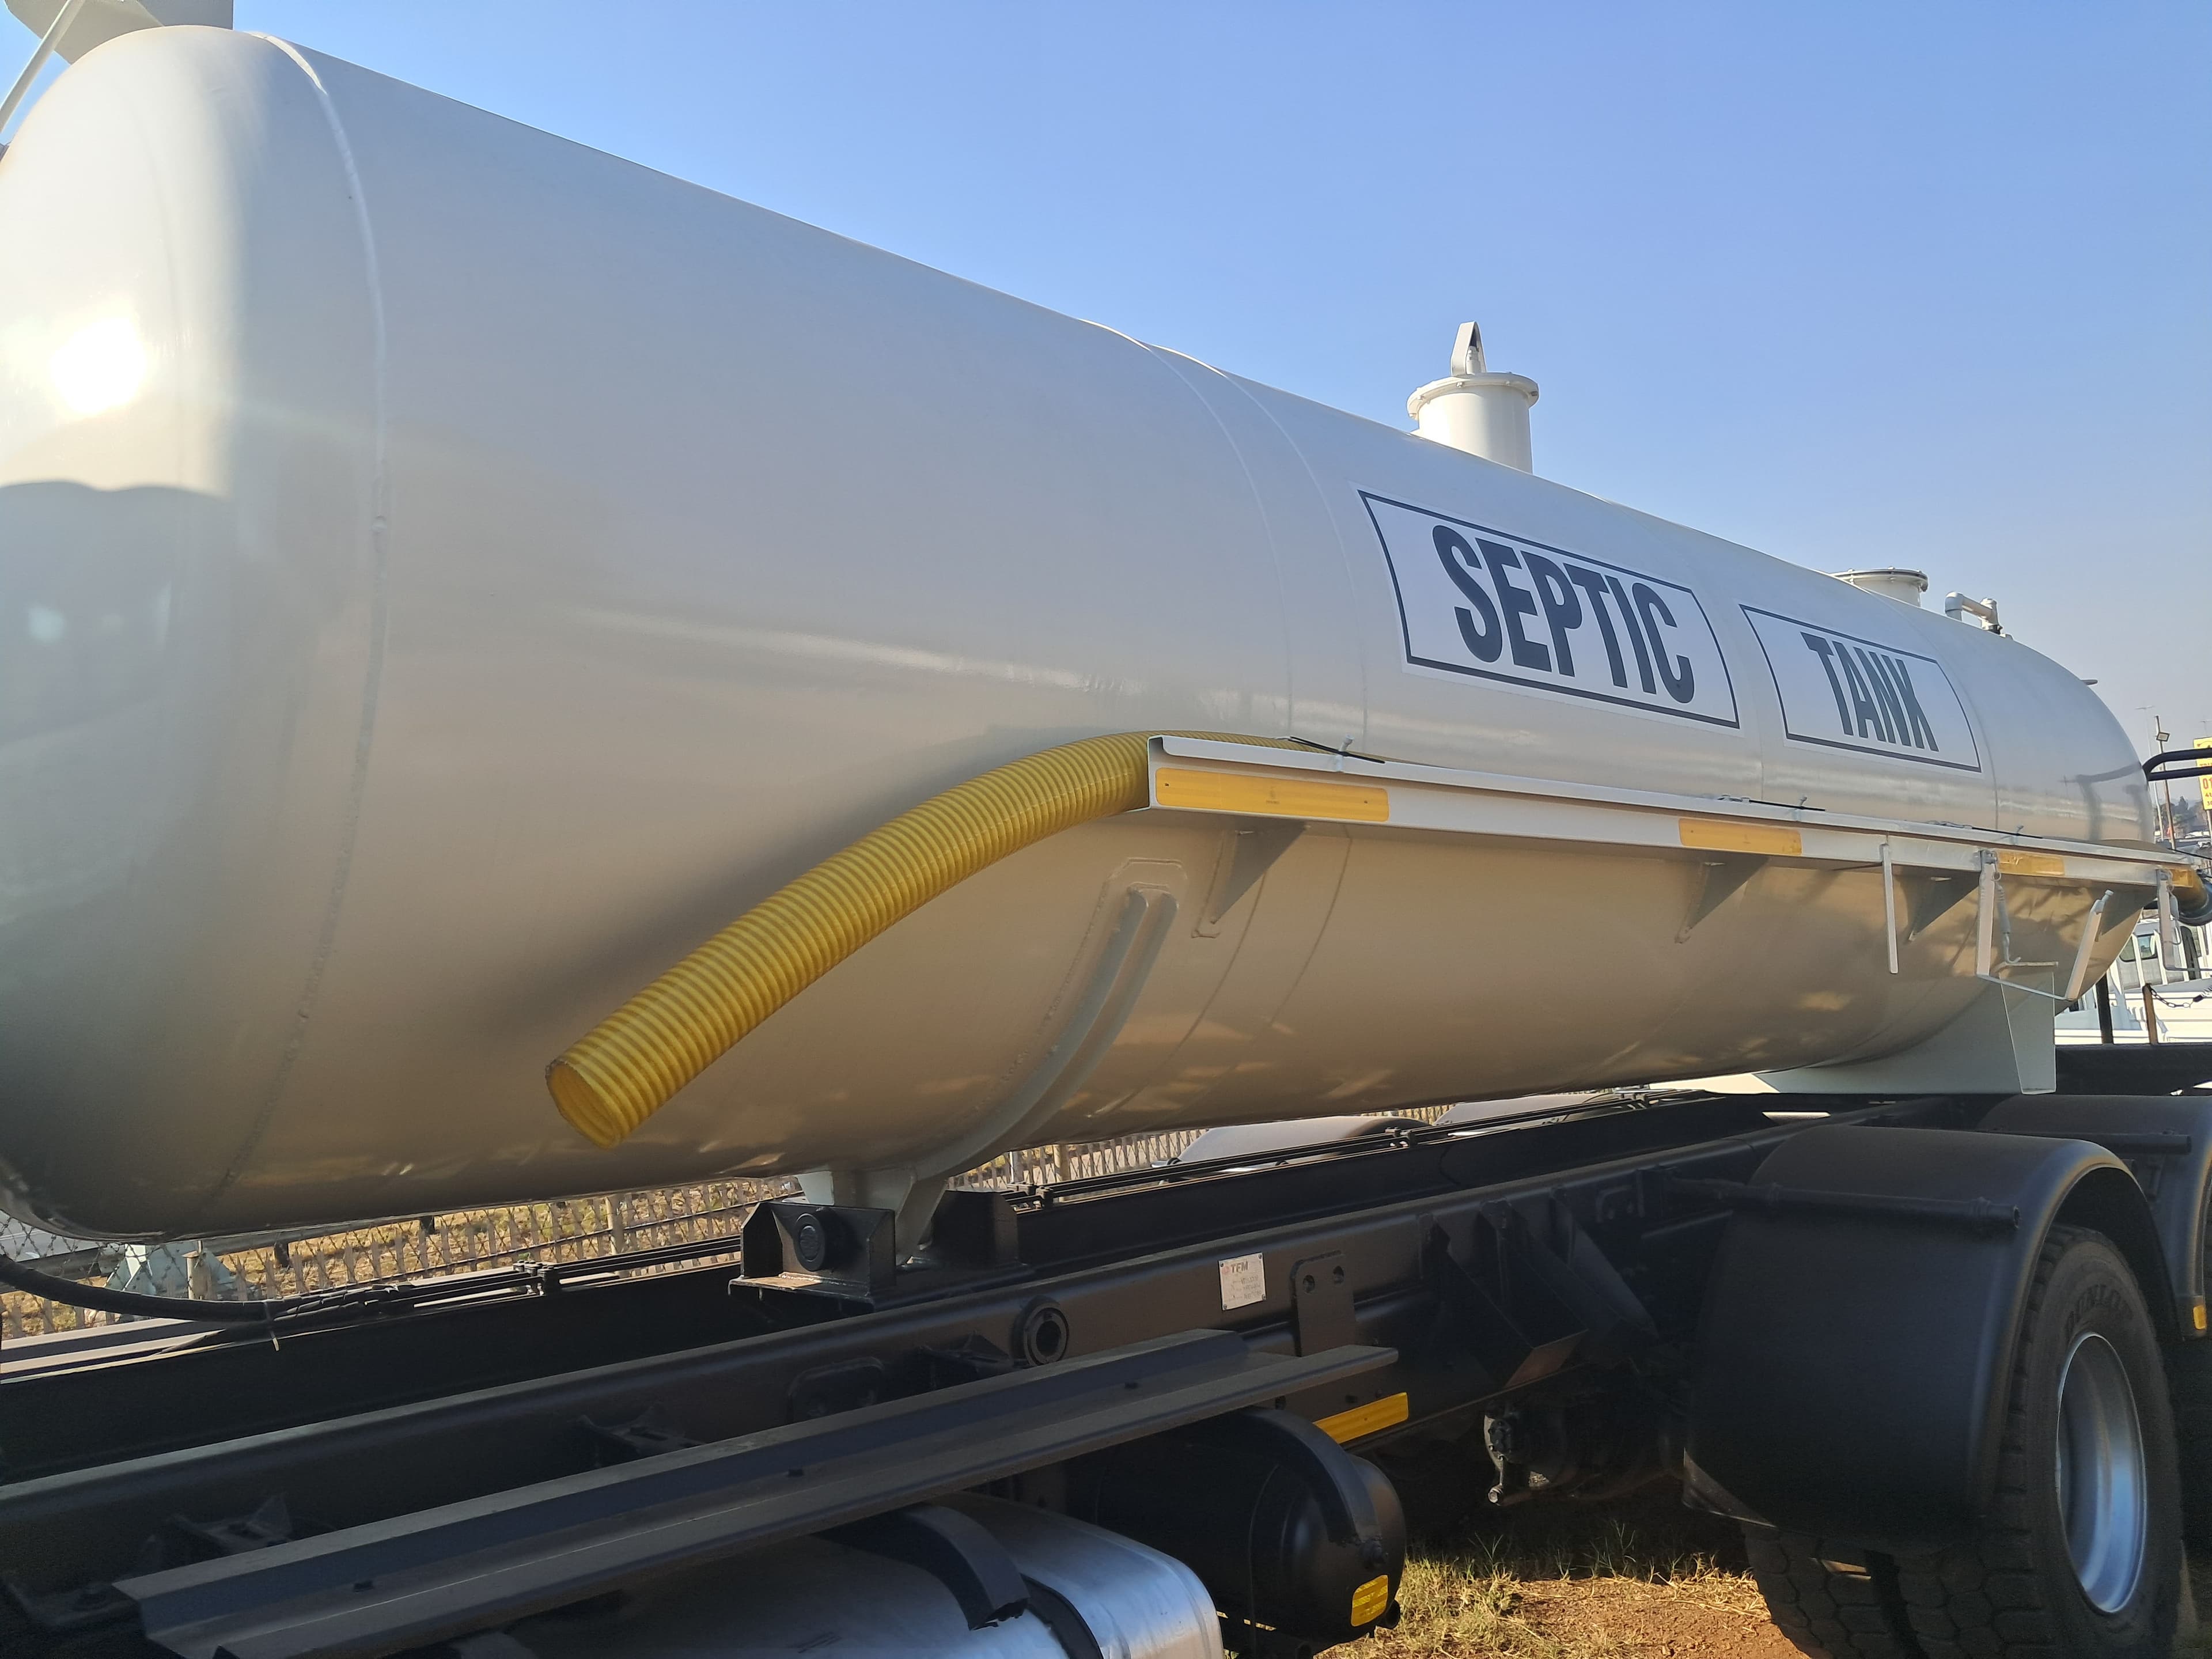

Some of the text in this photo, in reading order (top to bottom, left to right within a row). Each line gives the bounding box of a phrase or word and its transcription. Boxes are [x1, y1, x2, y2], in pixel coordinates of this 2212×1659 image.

[1433, 525, 1939, 752] SEPTIC TANK
[1230, 1261, 1248, 1273] TFM
